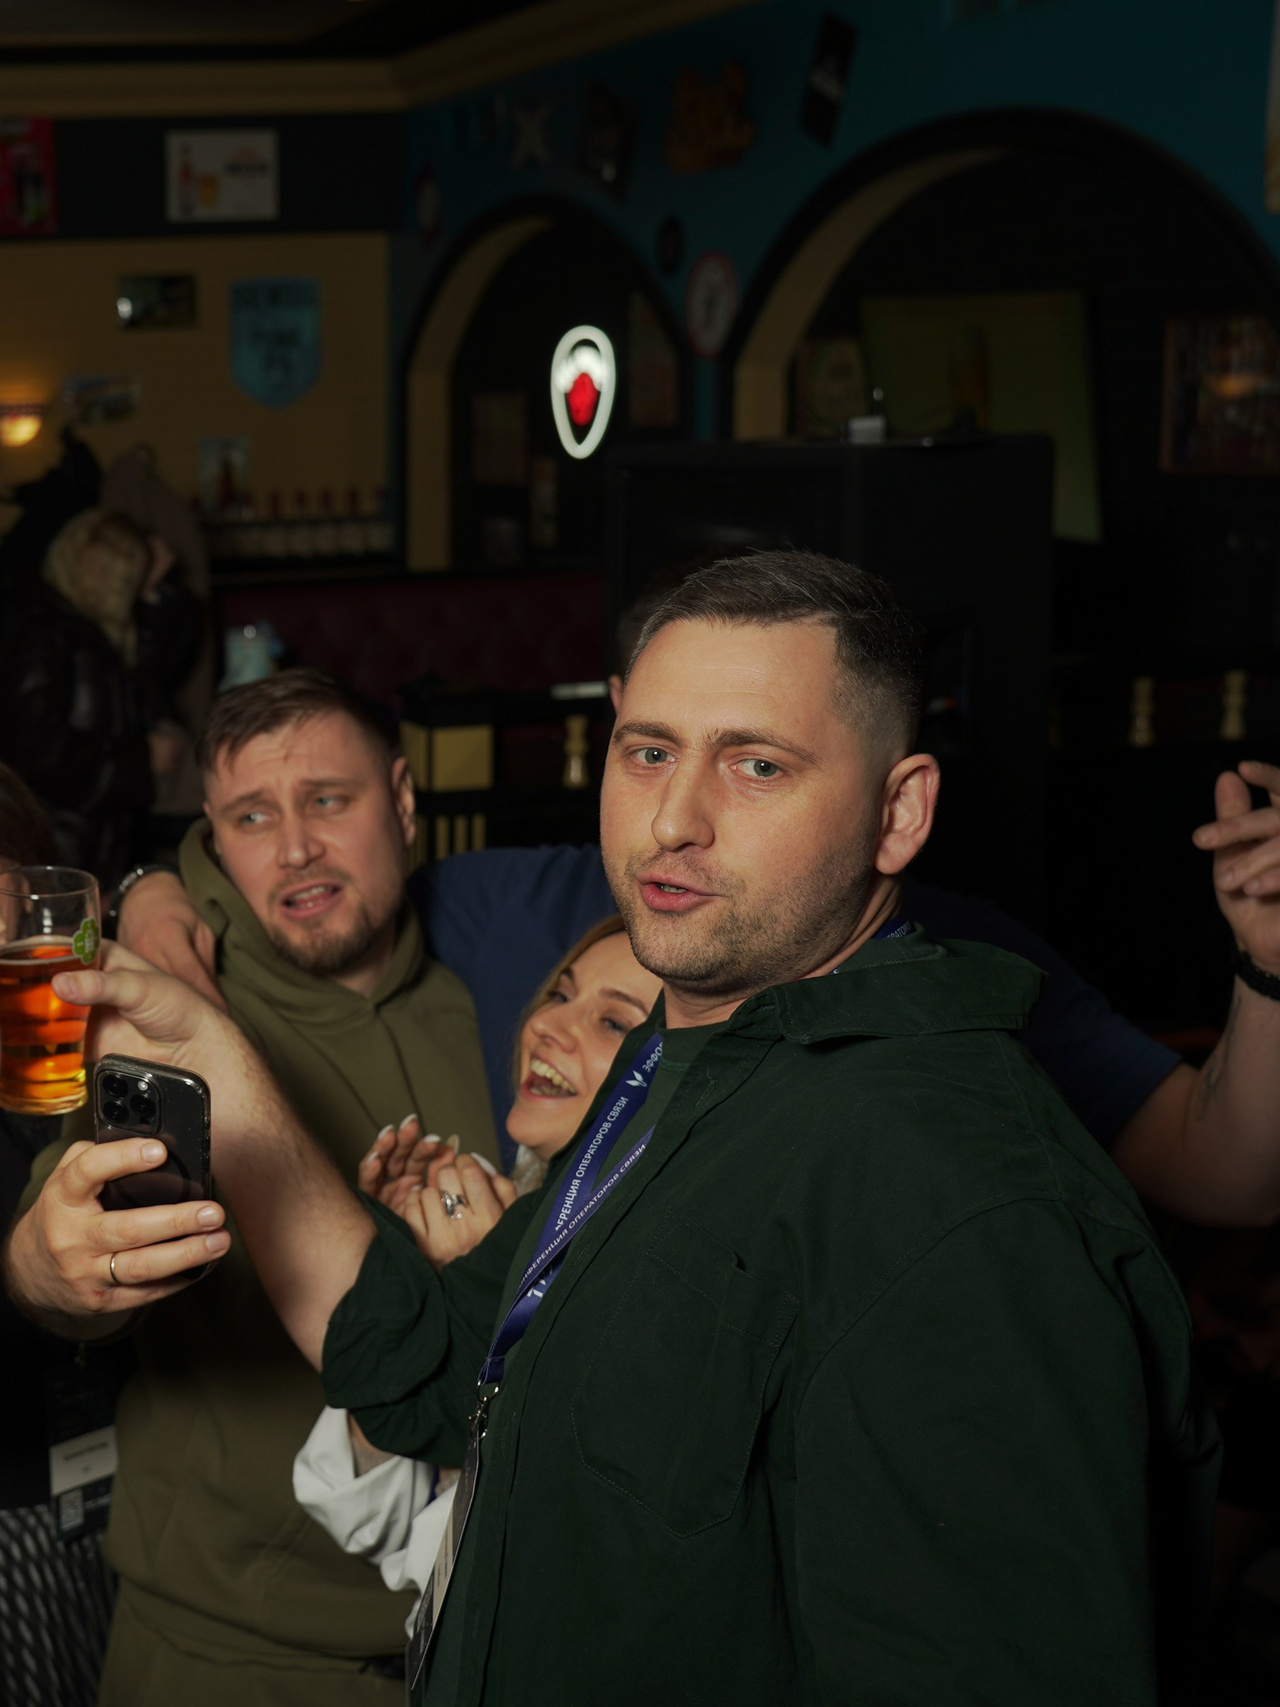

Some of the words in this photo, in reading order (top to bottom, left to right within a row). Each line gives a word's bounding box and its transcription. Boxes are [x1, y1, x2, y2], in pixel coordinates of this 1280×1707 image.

[576, 1122, 612, 1178] ОПЕРАТОРОВ
[607, 1096, 629, 1122] СВЯЗИ
[519, 1229, 568, 1288] НФЕРЕНЦИЯ
[568, 1173, 619, 1229] ОПЕРАТОРОВ
[620, 1144, 646, 1173] СВЯЗИ
